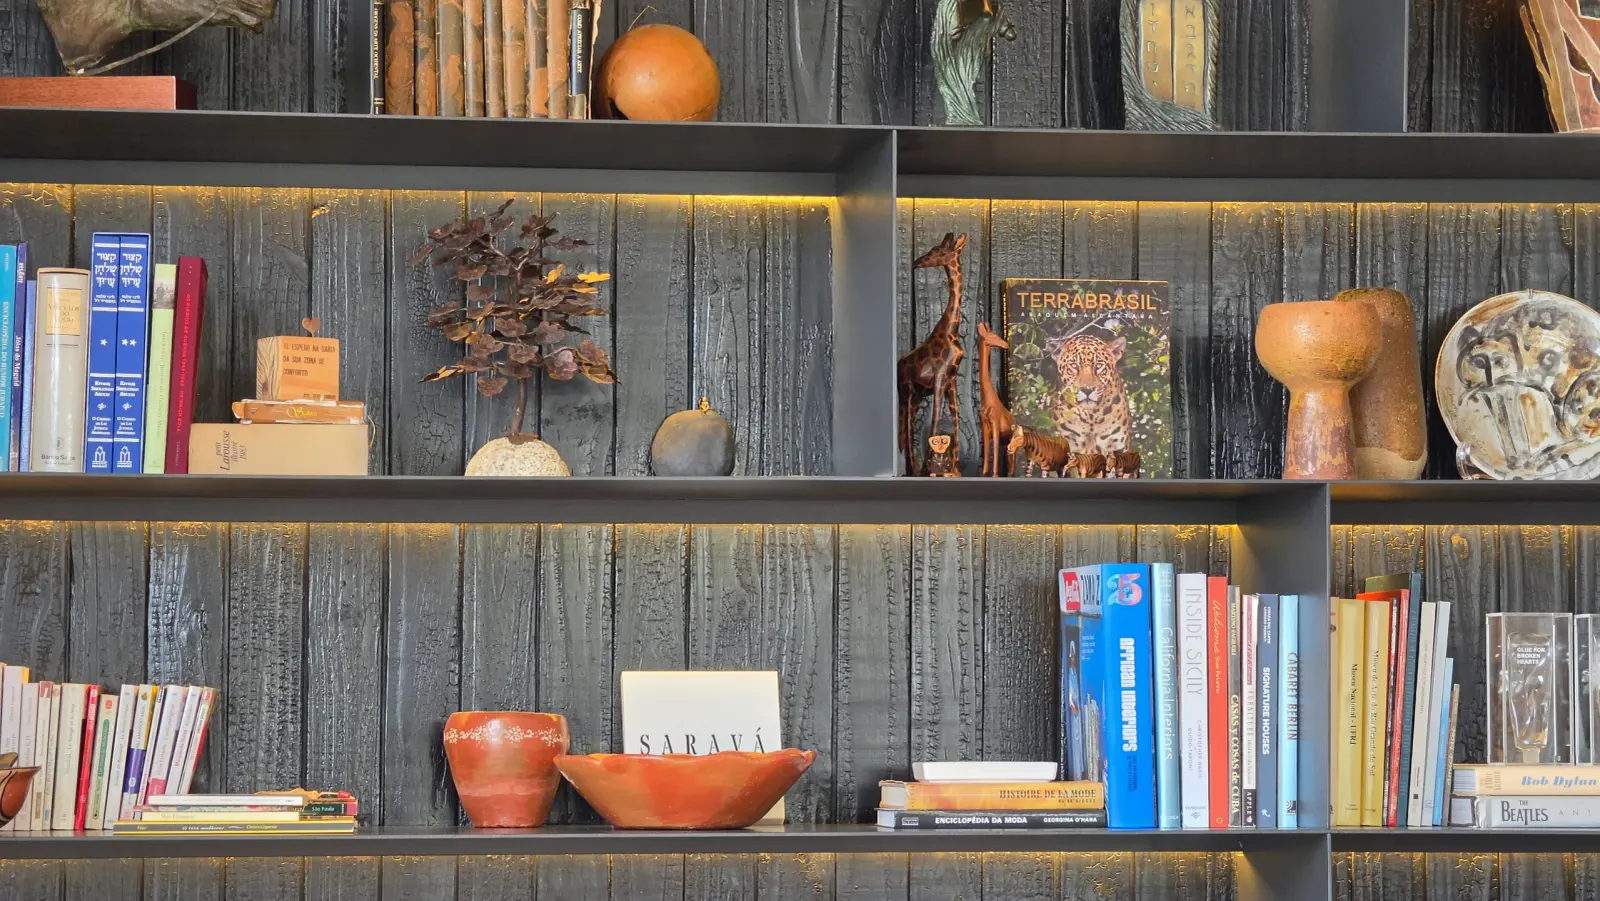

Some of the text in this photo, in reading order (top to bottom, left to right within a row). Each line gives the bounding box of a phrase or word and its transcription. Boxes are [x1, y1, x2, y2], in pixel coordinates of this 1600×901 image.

[1017, 292, 1156, 310] TERRABRASIL
[220, 431, 230, 471] Larousse
[1212, 600, 1223, 653] Welcome
[1185, 588, 1203, 696] INSIDE SICILY
[1161, 627, 1177, 760] California Interiors
[1287, 652, 1298, 740] CABARET BERLIN
[1231, 695, 1239, 726] CASAS
[640, 728, 765, 755] SARAVÁ
[1232, 737, 1240, 768] COSAS
[1232, 772, 1240, 783] de
[1522, 775, 1597, 788] Bob Dylan
[1000, 790, 1096, 798] HISTOIRE DE LA MODE
[1232, 786, 1240, 813] CUBA
[935, 816, 989, 824] ENCICLOPÉDIA
[1501, 800, 1548, 825] BEATLES
